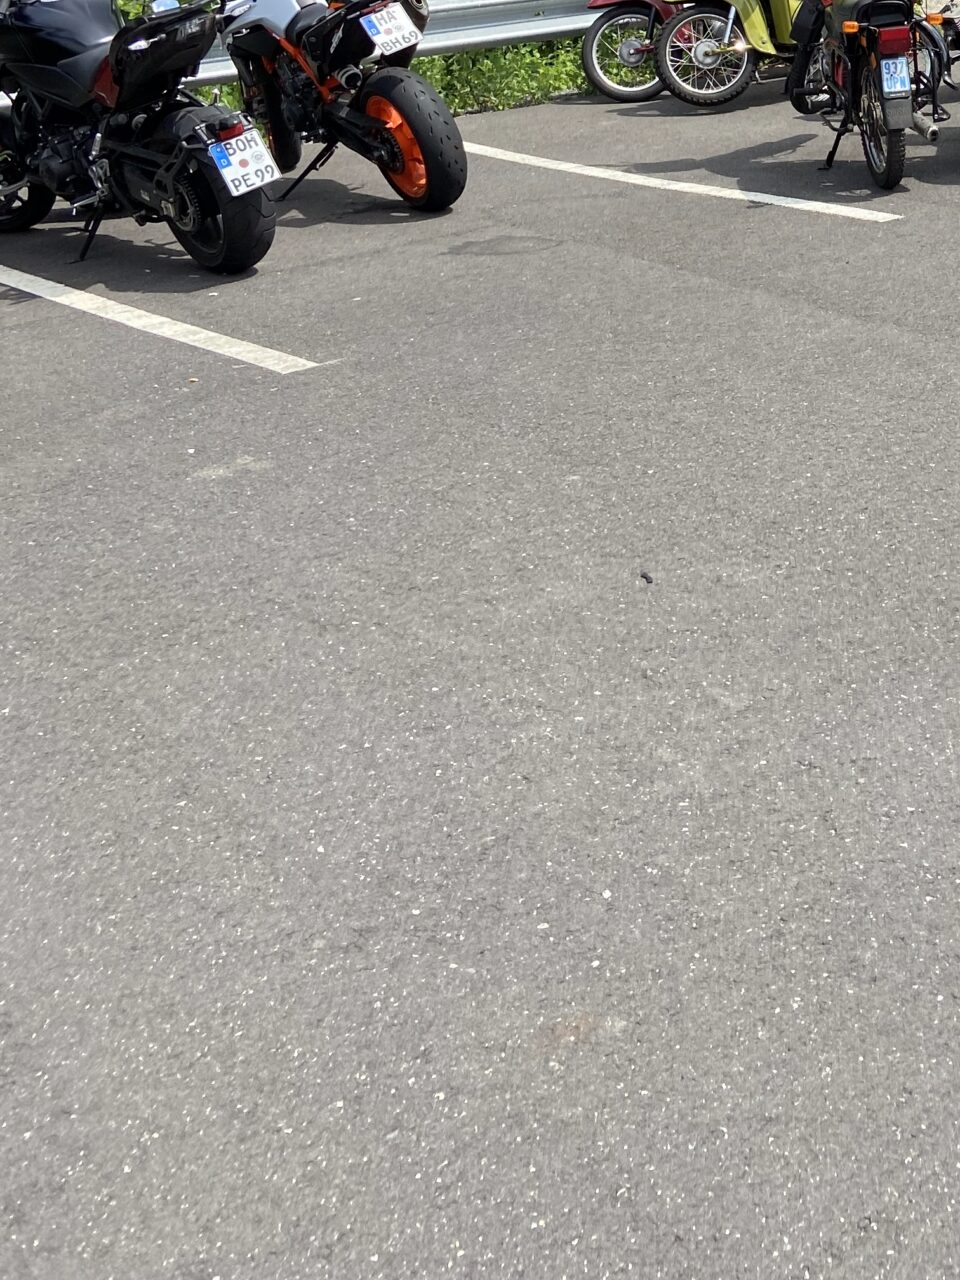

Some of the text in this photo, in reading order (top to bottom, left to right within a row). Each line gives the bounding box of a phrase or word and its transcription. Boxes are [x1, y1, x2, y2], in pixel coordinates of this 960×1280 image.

[374, 10, 398, 26] HA
[380, 30, 418, 52] BH 69
[884, 61, 905, 75] 937
[230, 164, 275, 193] PE 99
